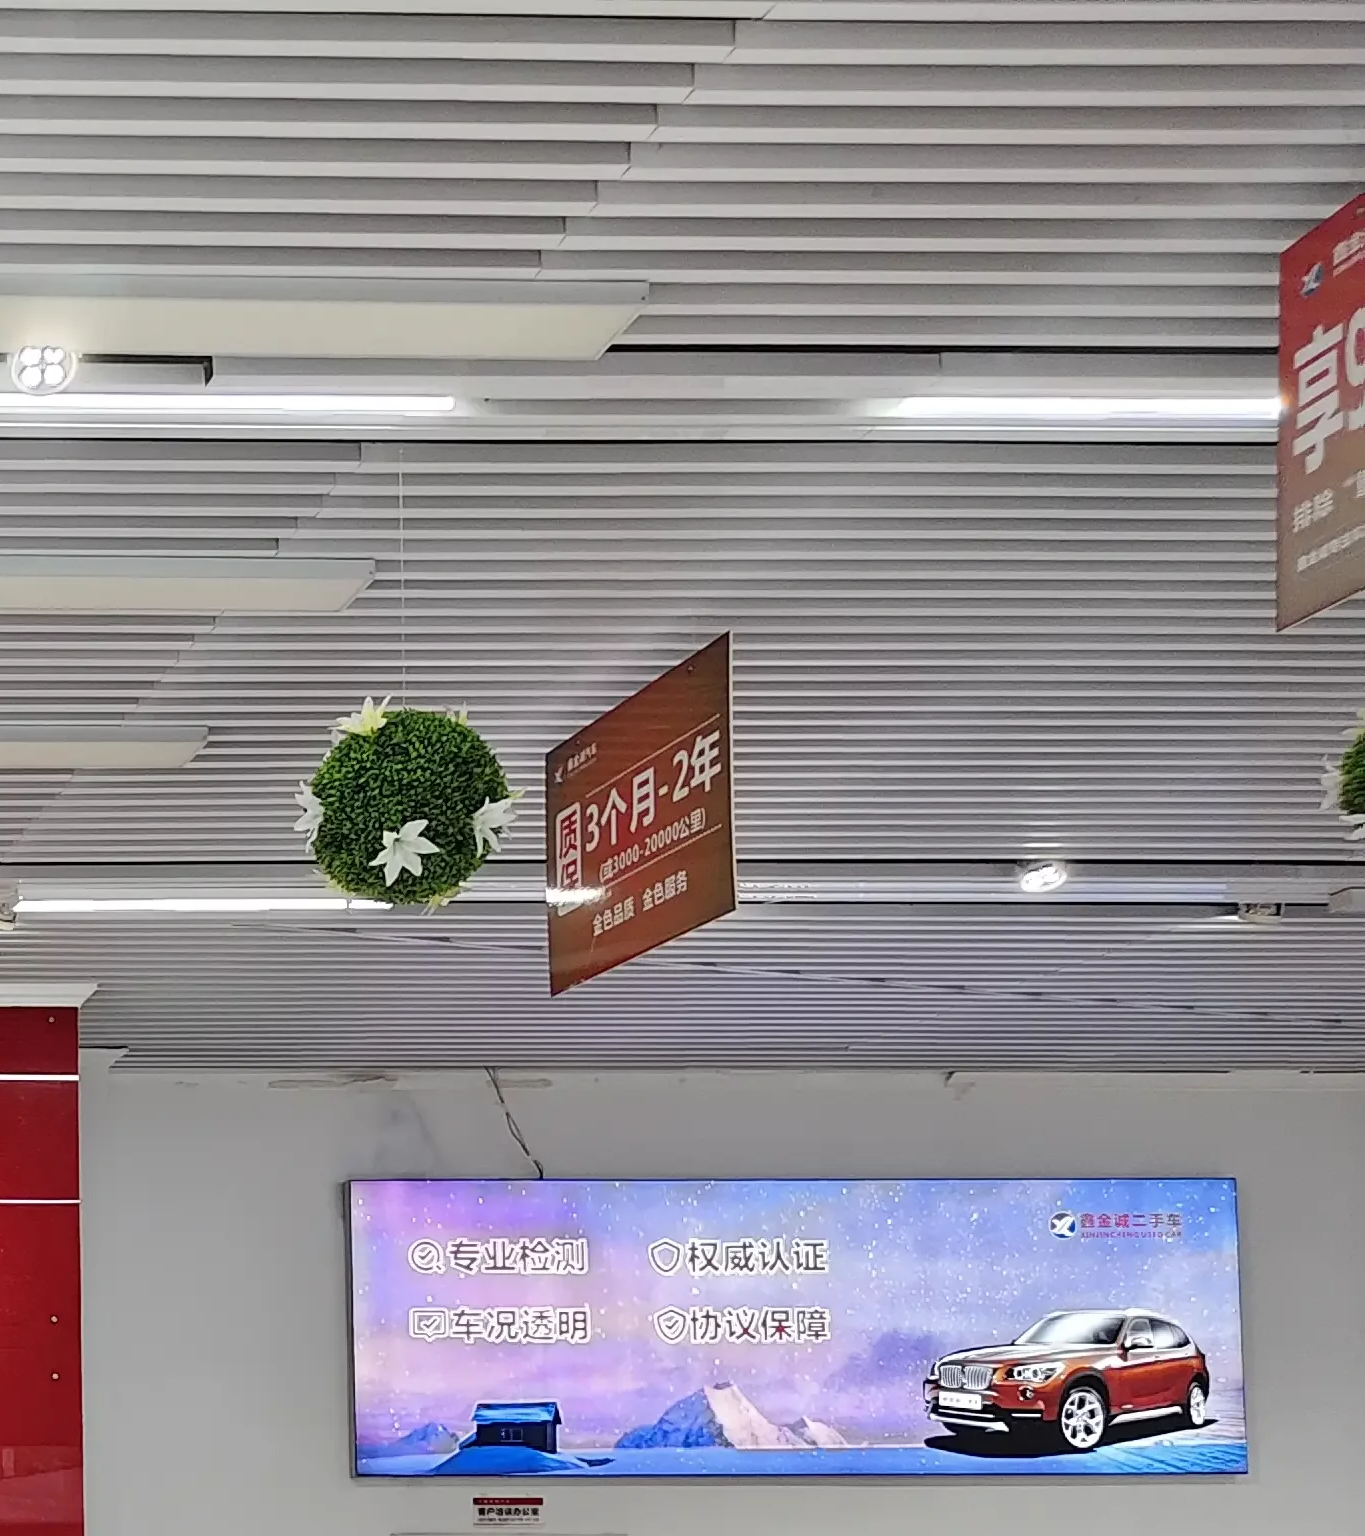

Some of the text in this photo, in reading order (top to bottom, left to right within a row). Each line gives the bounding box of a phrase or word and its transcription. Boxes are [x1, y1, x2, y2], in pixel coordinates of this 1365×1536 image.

[592, 869, 689, 937] 金色品质 金色服务
[1080, 1213, 1182, 1229] 鑫金诚二手车
[448, 1238, 589, 1275] 专业检测
[686, 1238, 830, 1275] 权威认证
[449, 1304, 591, 1344] 车况透明
[689, 1304, 831, 1344] 协议保障
